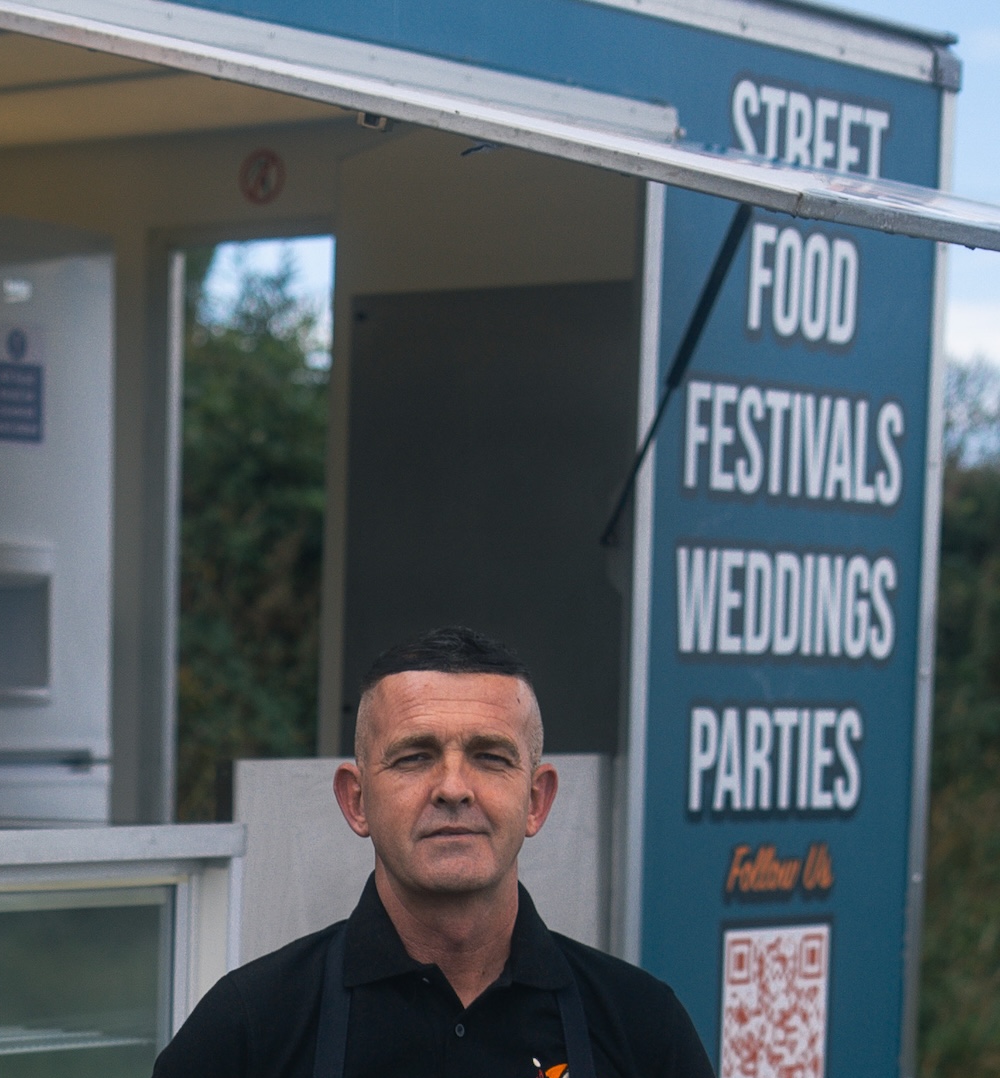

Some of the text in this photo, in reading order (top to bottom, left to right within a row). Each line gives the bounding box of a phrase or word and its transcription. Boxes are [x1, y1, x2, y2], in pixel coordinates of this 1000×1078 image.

[748, 223, 858, 344] FOOD
[685, 382, 904, 505] FESTIVALS
[678, 548, 895, 659] WEDDINGS
[690, 708, 862, 810] PARTIES
[726, 844, 834, 892] Follow Us
